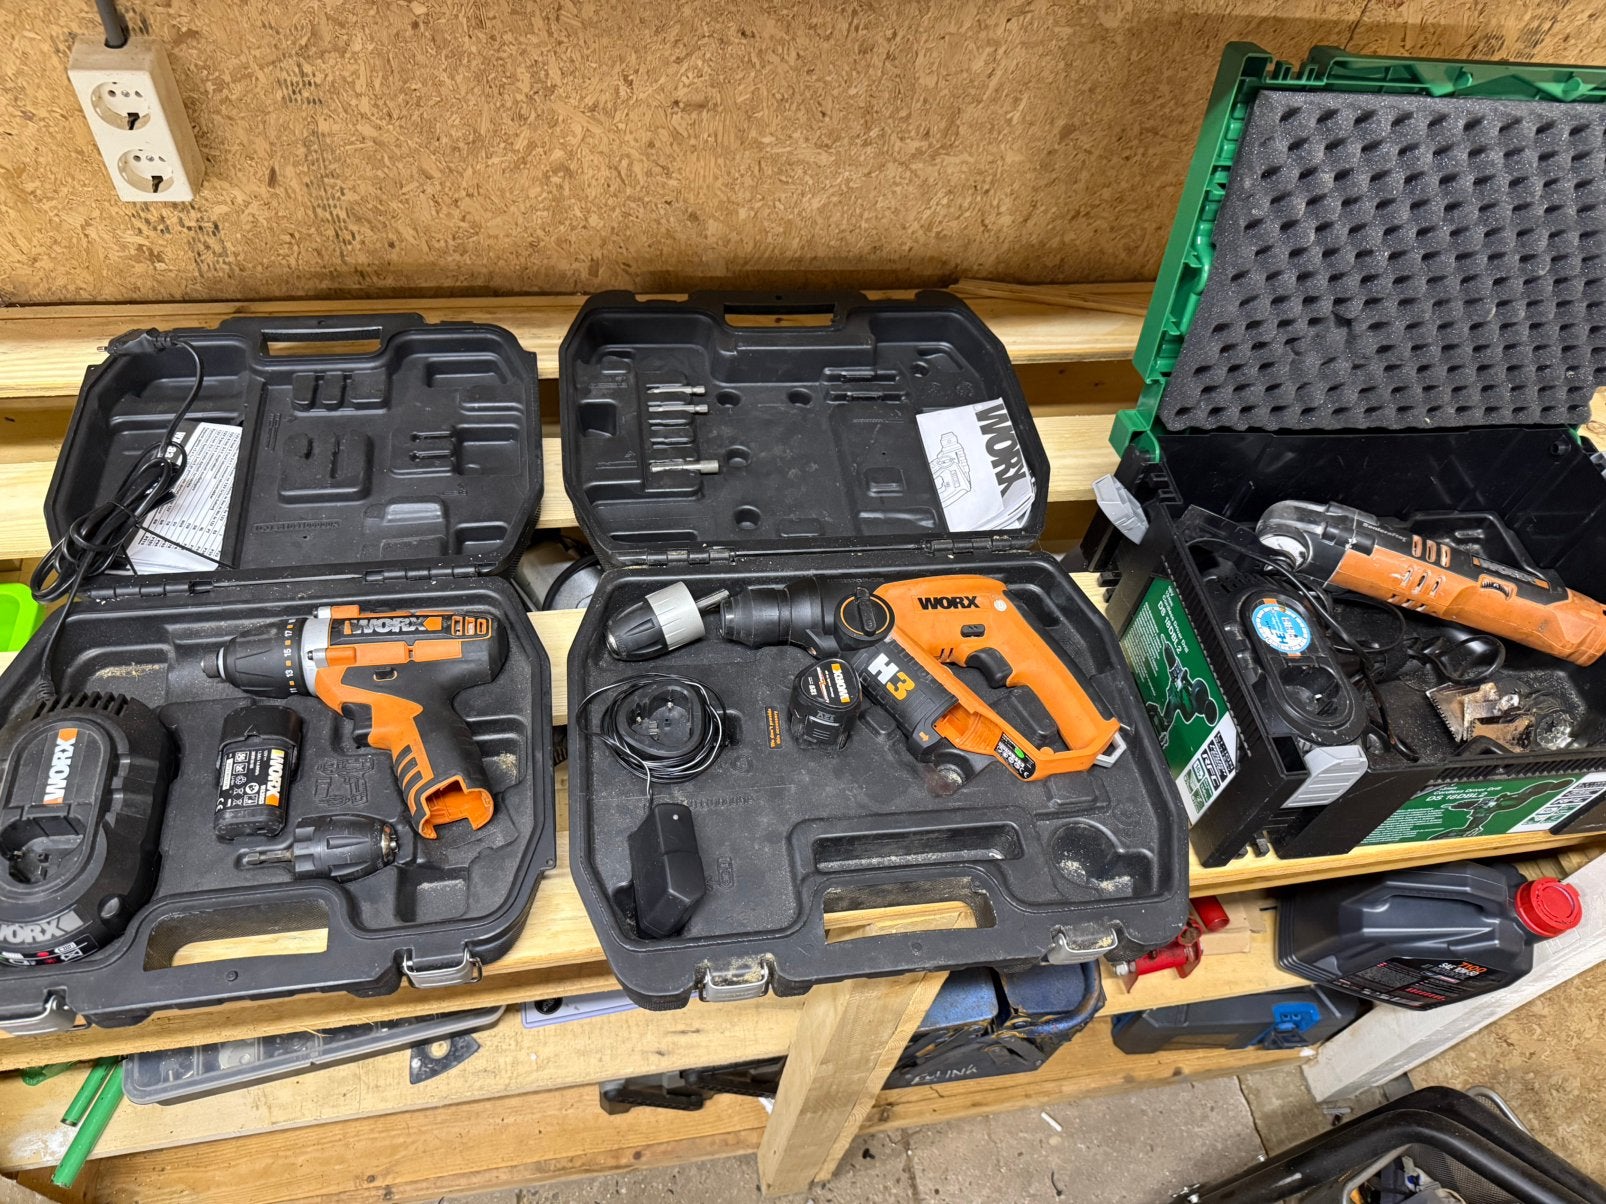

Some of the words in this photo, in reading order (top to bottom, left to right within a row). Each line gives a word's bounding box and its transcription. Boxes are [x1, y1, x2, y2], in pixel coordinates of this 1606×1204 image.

[974, 403, 1026, 498] WORX
[918, 595, 980, 610] WORX
[1157, 600, 1166, 616] DS
[351, 616, 426, 634] WORX
[1162, 594, 1174, 622] Cordless
[1173, 620, 1183, 639] Driver
[1181, 639, 1189, 653] Drill
[283, 648, 292, 657] 15
[285, 669, 294, 678] 13
[833, 670, 850, 699] WORX
[868, 653, 916, 701] H3
[45, 738, 77, 801] WORX
[266, 755, 284, 796] WORX
[1202, 753, 1219, 787] RFC
[1459, 961, 1488, 972] 7100
